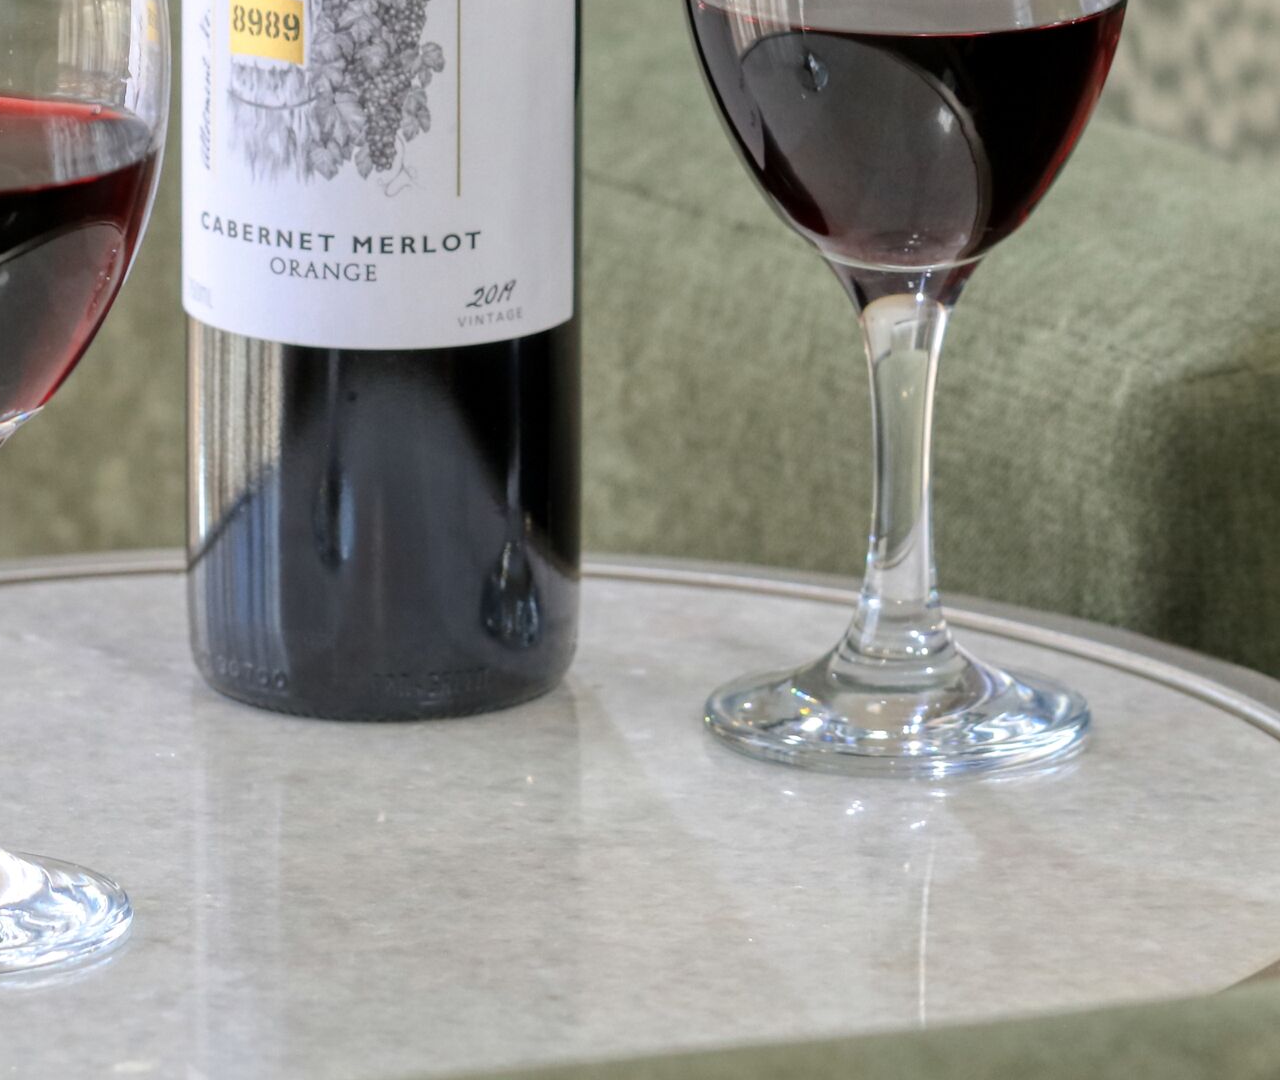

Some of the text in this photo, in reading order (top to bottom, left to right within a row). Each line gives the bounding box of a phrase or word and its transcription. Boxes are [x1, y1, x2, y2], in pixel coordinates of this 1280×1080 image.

[232, 4, 301, 42] 8989
[200, 211, 482, 255] CABERNET MERLOT
[269, 256, 378, 283] ORANGE
[465, 278, 517, 308] 2019
[457, 306, 523, 328] VINTAGE
